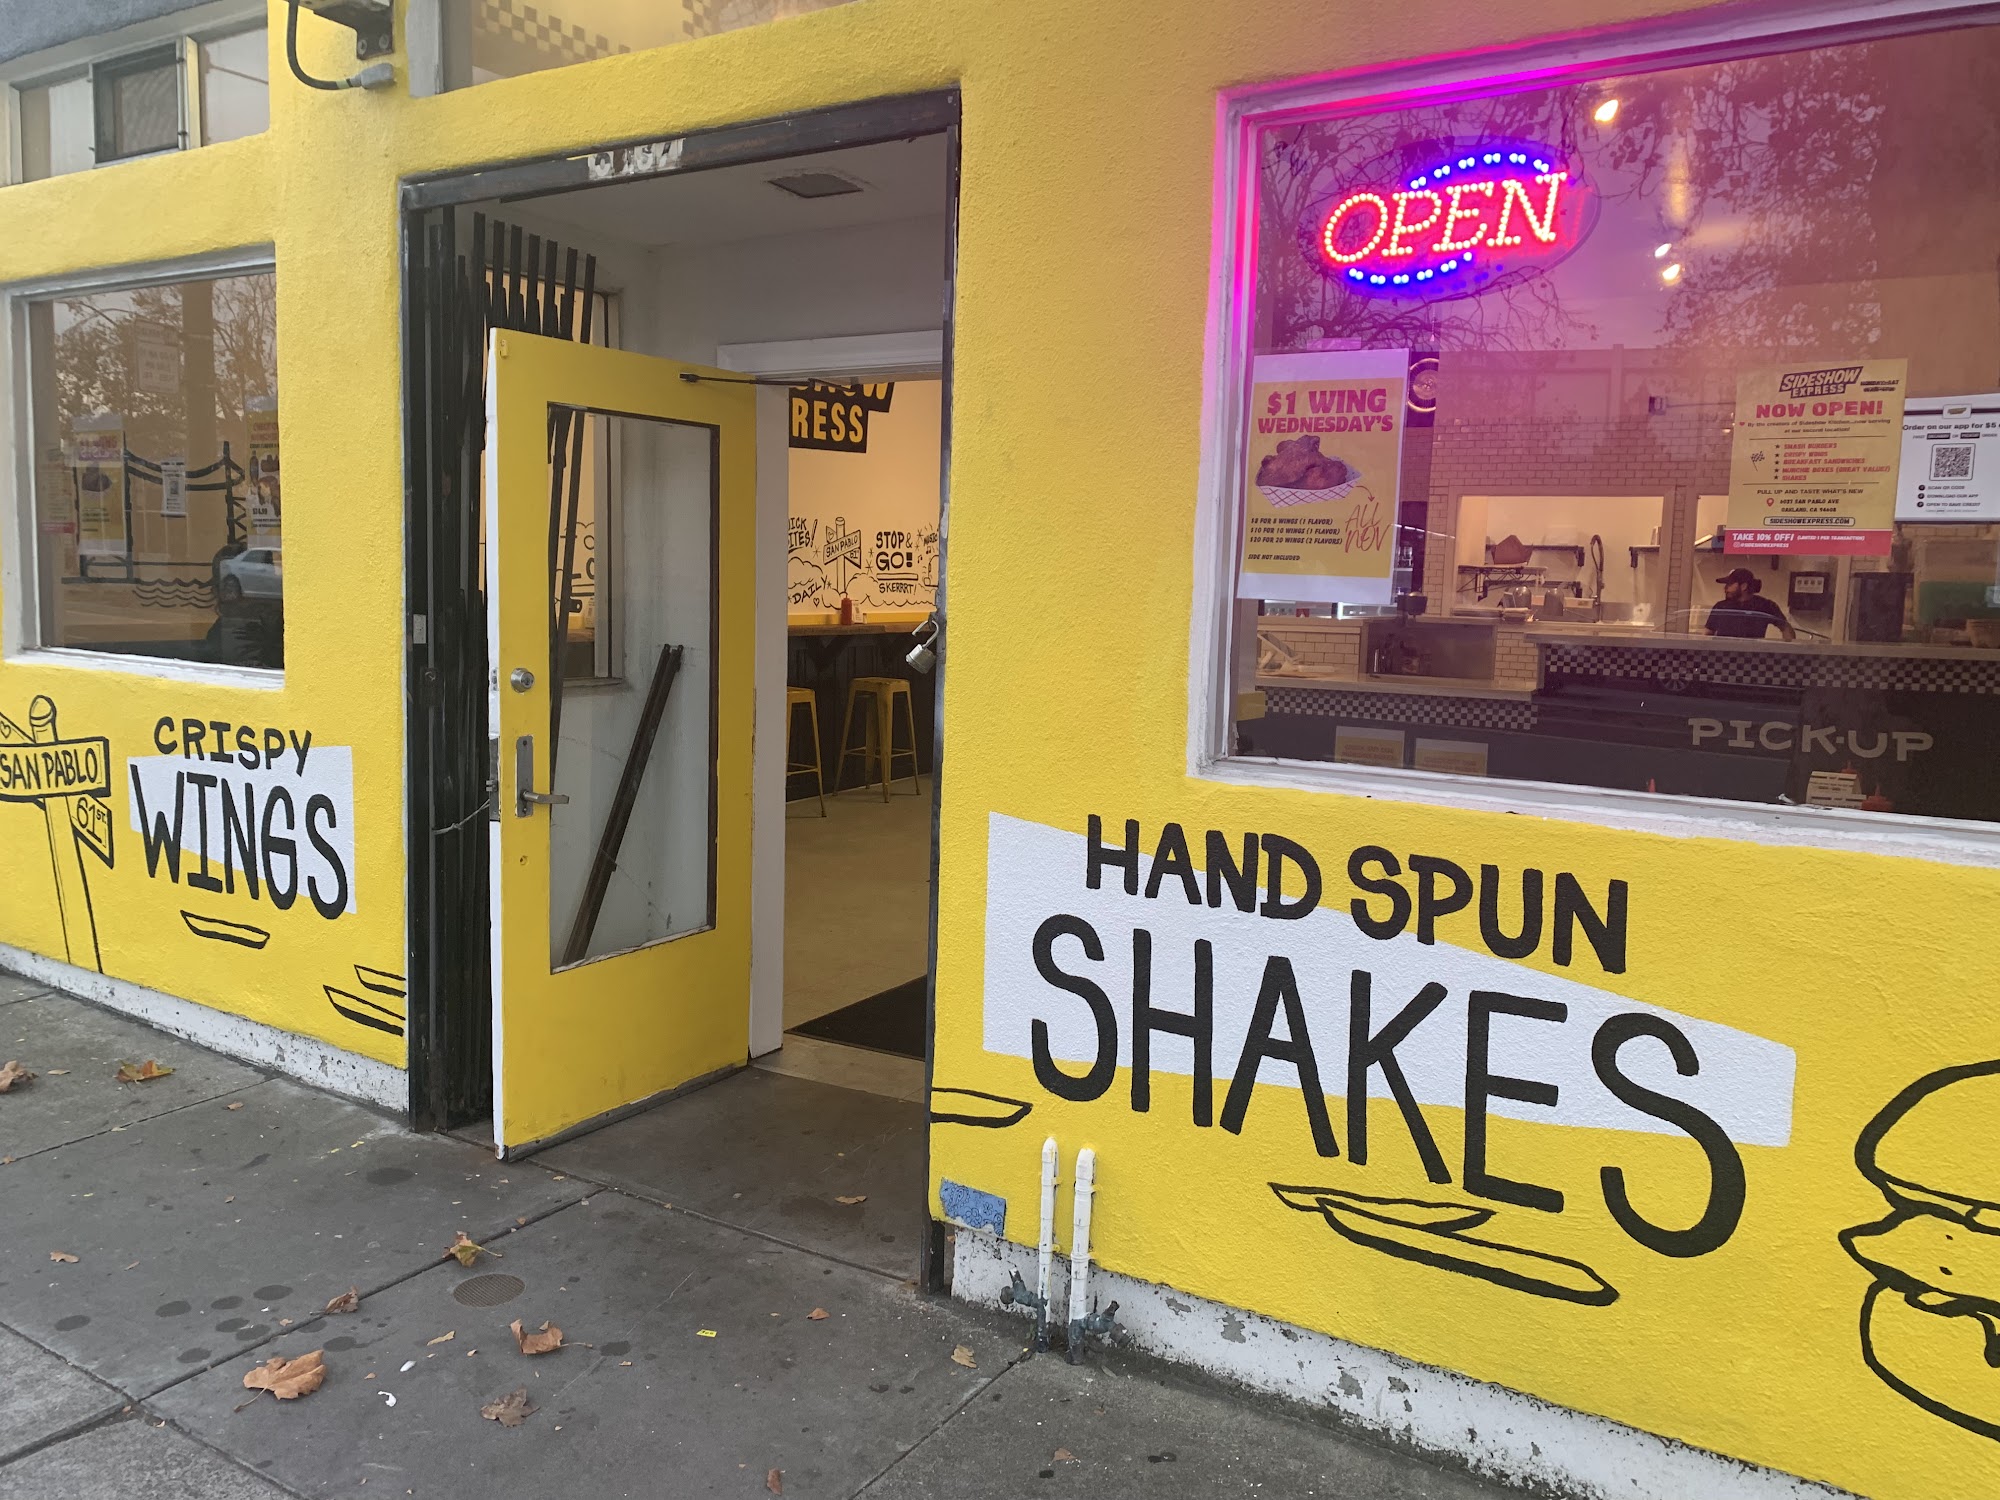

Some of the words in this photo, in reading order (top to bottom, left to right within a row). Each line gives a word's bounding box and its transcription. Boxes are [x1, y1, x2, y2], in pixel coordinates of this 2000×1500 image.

[1324, 171, 1567, 263] OPEN
[1781, 368, 1860, 391] SIDESHOW
[1792, 384, 1845, 398] EXPRESS
[1267, 391, 1296, 416] $1
[1308, 388, 1387, 414] WING
[1756, 402, 1806, 418] NOW
[1812, 401, 1883, 416] OPEN!
[792, 397, 863, 443] RESS
[1258, 415, 1393, 434] WEDNESDAY'S
[788, 519, 818, 548] ITES!
[826, 545, 840, 558] SAN
[840, 535, 858, 552] PABLO
[876, 530, 905, 549] STOP
[905, 532, 913, 549] &
[1732, 533, 1754, 541] TAKE
[1757, 533, 1771, 541] 10%
[1774, 533, 1794, 541] OFF!
[876, 552, 913, 571] GO!
[792, 575, 828, 605] DAILY
[879, 582, 917, 595] SKERRRT!
[153, 715, 312, 776] CRISPY
[0, 752, 41, 789] SAN
[42, 747, 98, 788] PABLO
[130, 764, 348, 920] WINGS
[1086, 813, 1323, 920] HAND
[1348, 844, 1629, 974] SPUN
[1030, 912, 1748, 1258] SHAKES
